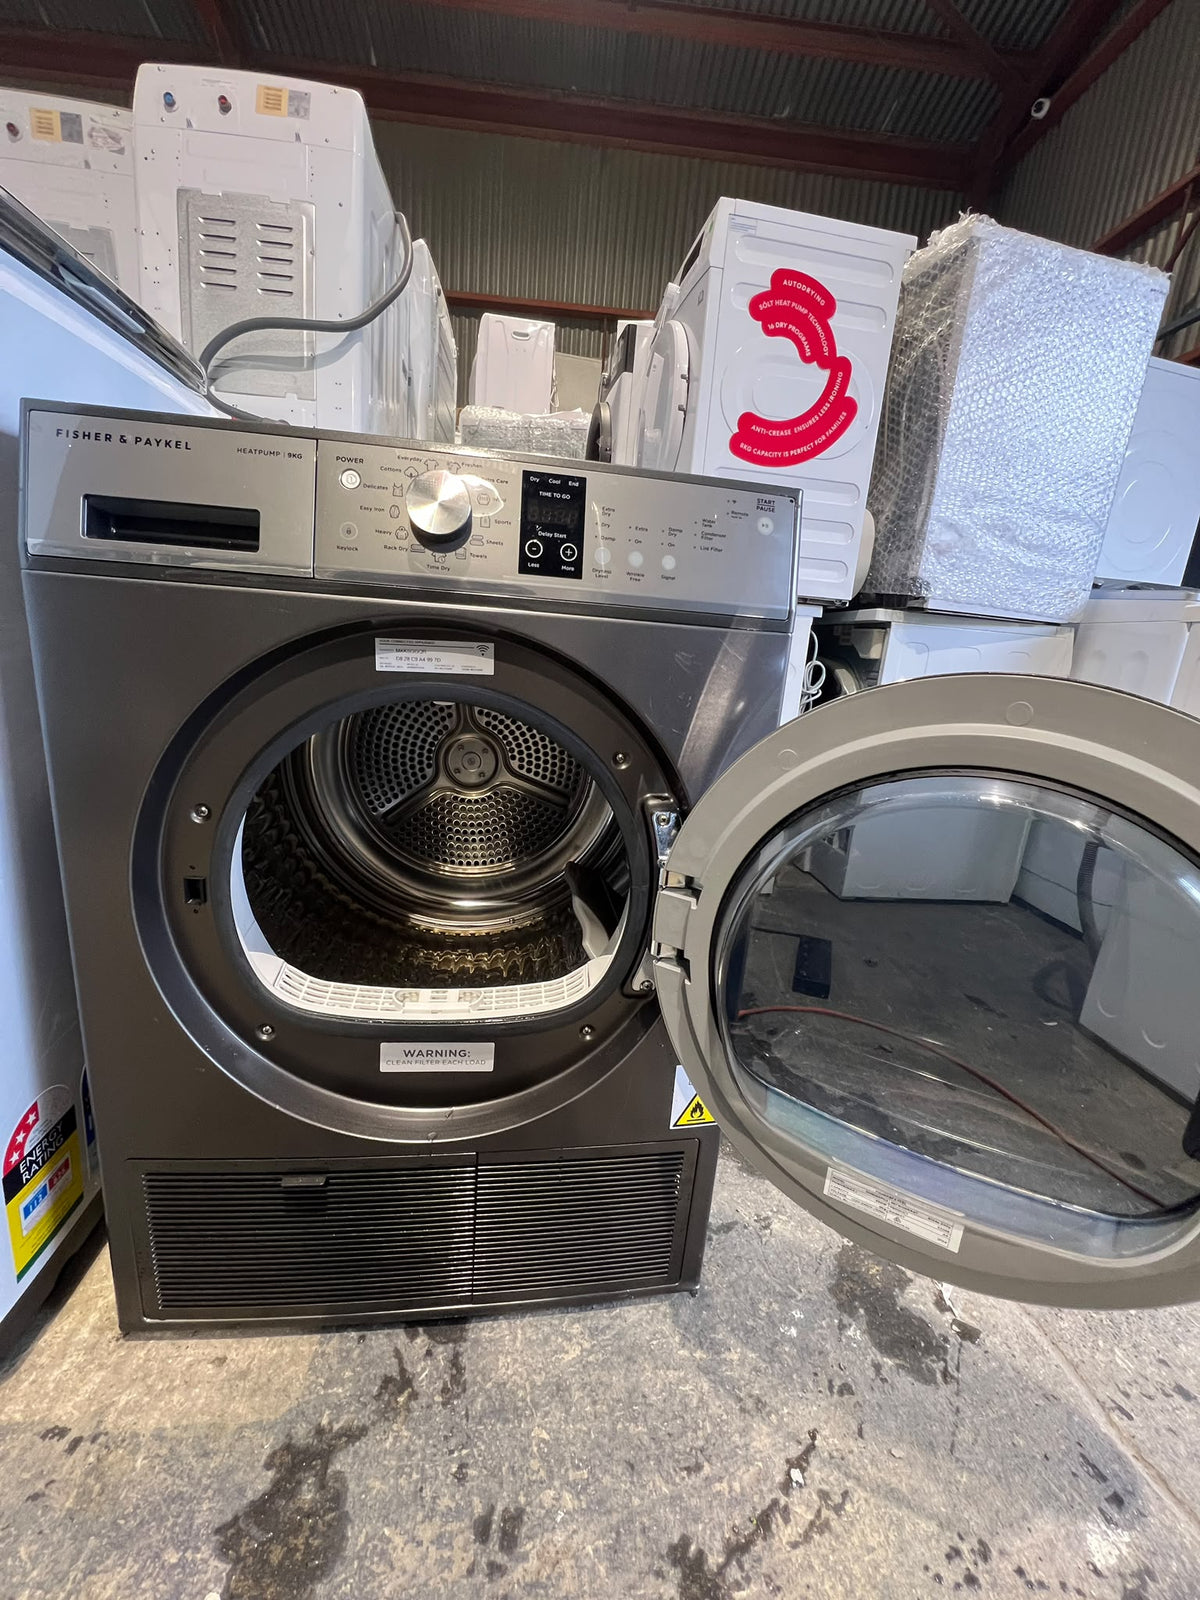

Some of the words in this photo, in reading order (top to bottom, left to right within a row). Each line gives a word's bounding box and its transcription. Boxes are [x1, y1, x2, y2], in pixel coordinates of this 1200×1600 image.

[783, 279, 825, 306] AUTODRYING
[788, 325, 811, 356] PROGRAMS
[792, 302, 808, 314] PUMP
[808, 313, 828, 356] TECHNOLOGY
[751, 425, 791, 436] ANTI-CREASE
[794, 415, 819, 433] ENSURES
[819, 403, 830, 416] LESS
[829, 372, 843, 403] IRONING
[56, 428, 112, 442] FISHER
[119, 434, 128, 444] &
[135, 436, 192, 450] PAYKEL
[740, 442, 752, 452] 8KG
[753, 449, 782, 458] CAPACITY
[790, 443, 814, 456] PERFECT
[814, 436, 826, 446] FOR
[826, 412, 847, 437] FAMILIES
[237, 447, 281, 458] HEATPUMP
[336, 456, 364, 464] POWER
[403, 1050, 471, 1058] WARNING:
[20, 1120, 63, 1174] ENERGY
[22, 1134, 64, 1185] RATING
